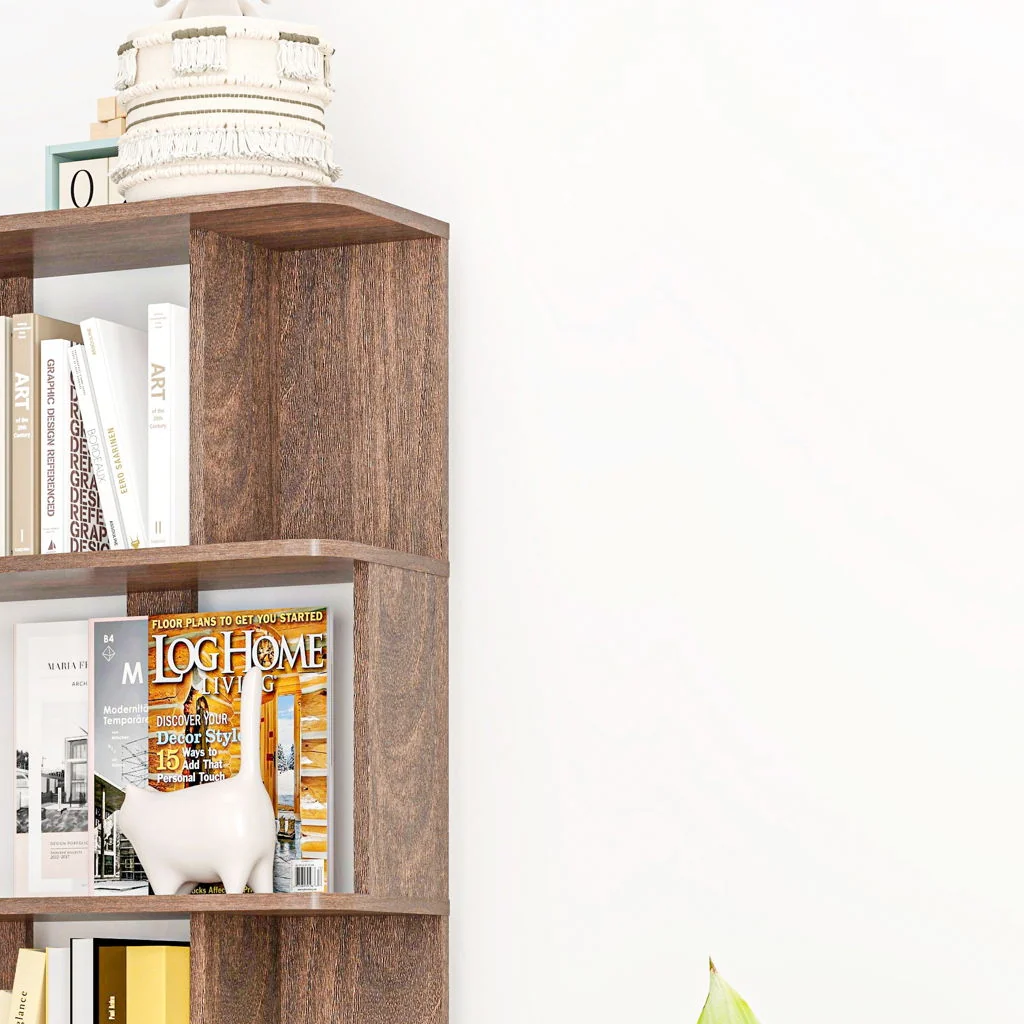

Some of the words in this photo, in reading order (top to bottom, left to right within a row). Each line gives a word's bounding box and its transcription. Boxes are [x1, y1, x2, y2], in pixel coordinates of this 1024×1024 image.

[15, 372, 29, 410] ART
[47, 359, 55, 405] GRAPHIC
[151, 363, 166, 400] ART
[47, 408, 55, 445] DESIGN
[87, 428, 106, 482] BORDEAUX
[107, 427, 123, 470] SAARINEN
[47, 450, 55, 516] REFERENCED
[116, 473, 128, 494] EERO
[152, 618, 183, 629] FLOOR
[185, 616, 217, 627] PLANS
[219, 615, 232, 626] TO
[236, 615, 253, 625] GET
[257, 613, 276, 624] YOU
[280, 611, 323, 622] STARTED
[48, 661, 77, 670] MARIA
[122, 661, 143, 685] M
[202, 674, 275, 695] LIVIG
[156, 714, 201, 727] DISCOVER
[204, 712, 228, 725] YOUR
[156, 731, 202, 745] Decor
[156, 749, 180, 770] 15
[182, 747, 205, 758] Ways
[208, 747, 218, 757] to
[182, 759, 200, 770] Add
[203, 759, 223, 769] That
[157, 771, 196, 783] Personal
[199, 771, 225, 782] Touch
